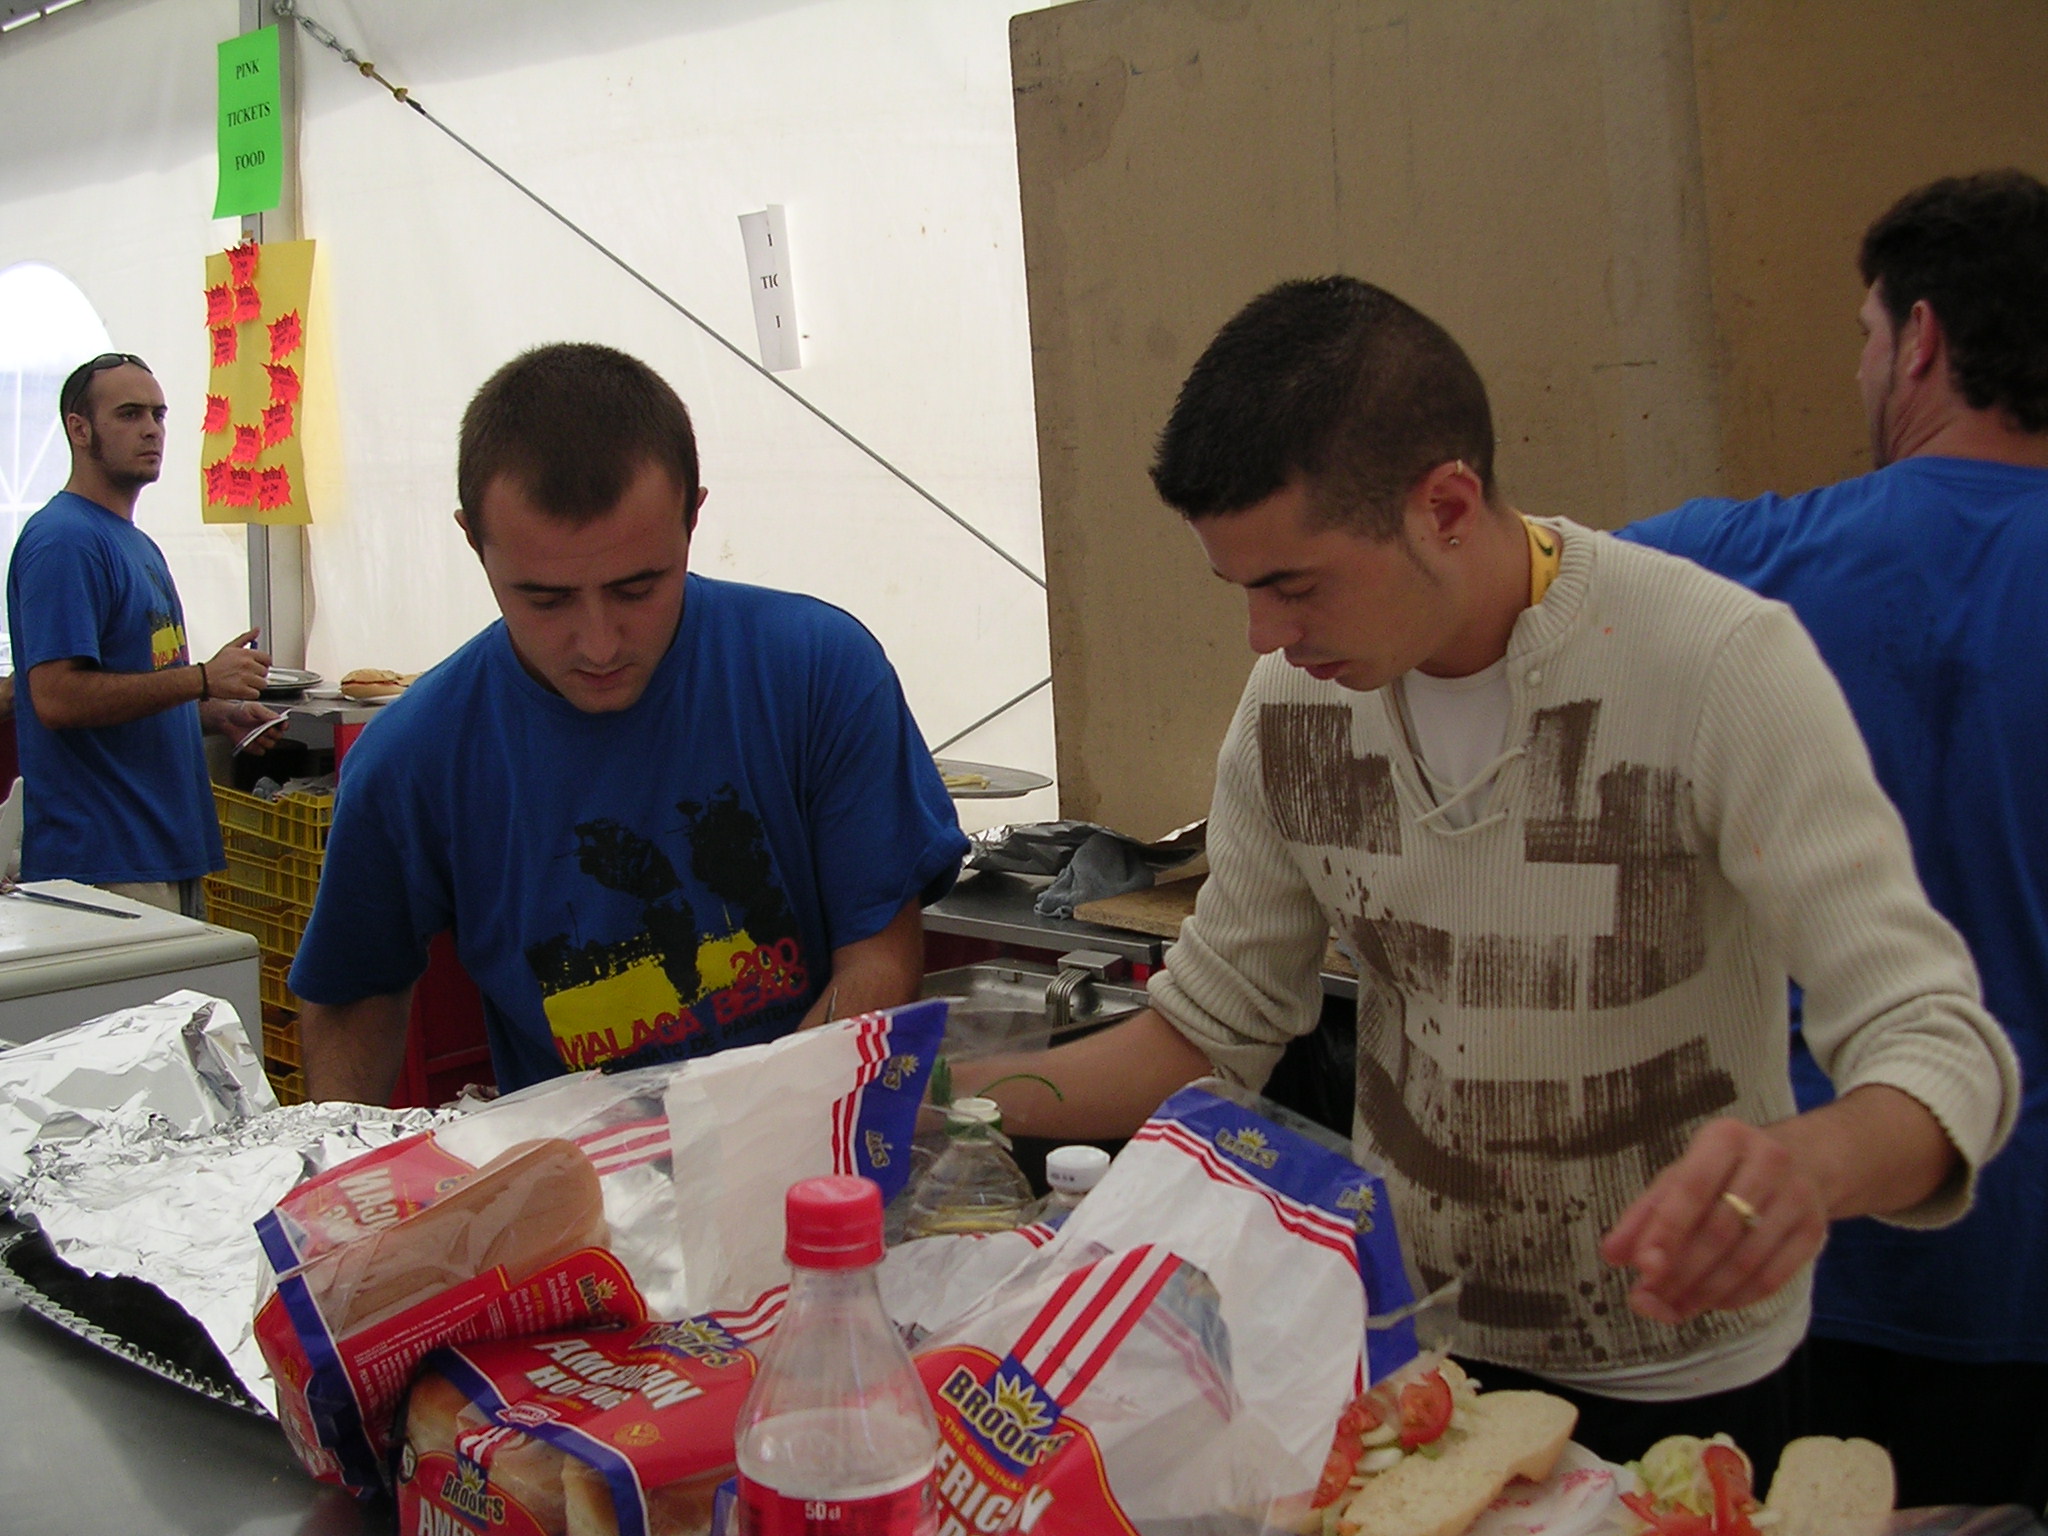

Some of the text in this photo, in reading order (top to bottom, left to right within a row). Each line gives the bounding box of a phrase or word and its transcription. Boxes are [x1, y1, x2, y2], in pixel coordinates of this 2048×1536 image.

[235, 59, 260, 80] PINK
[226, 102, 271, 127] TICKETS
[234, 150, 266, 171] FOOD
[552, 1006, 701, 1067] MALAGA
[440, 1470, 506, 1526] BROOK'S
[804, 1501, 827, 1521] 50
